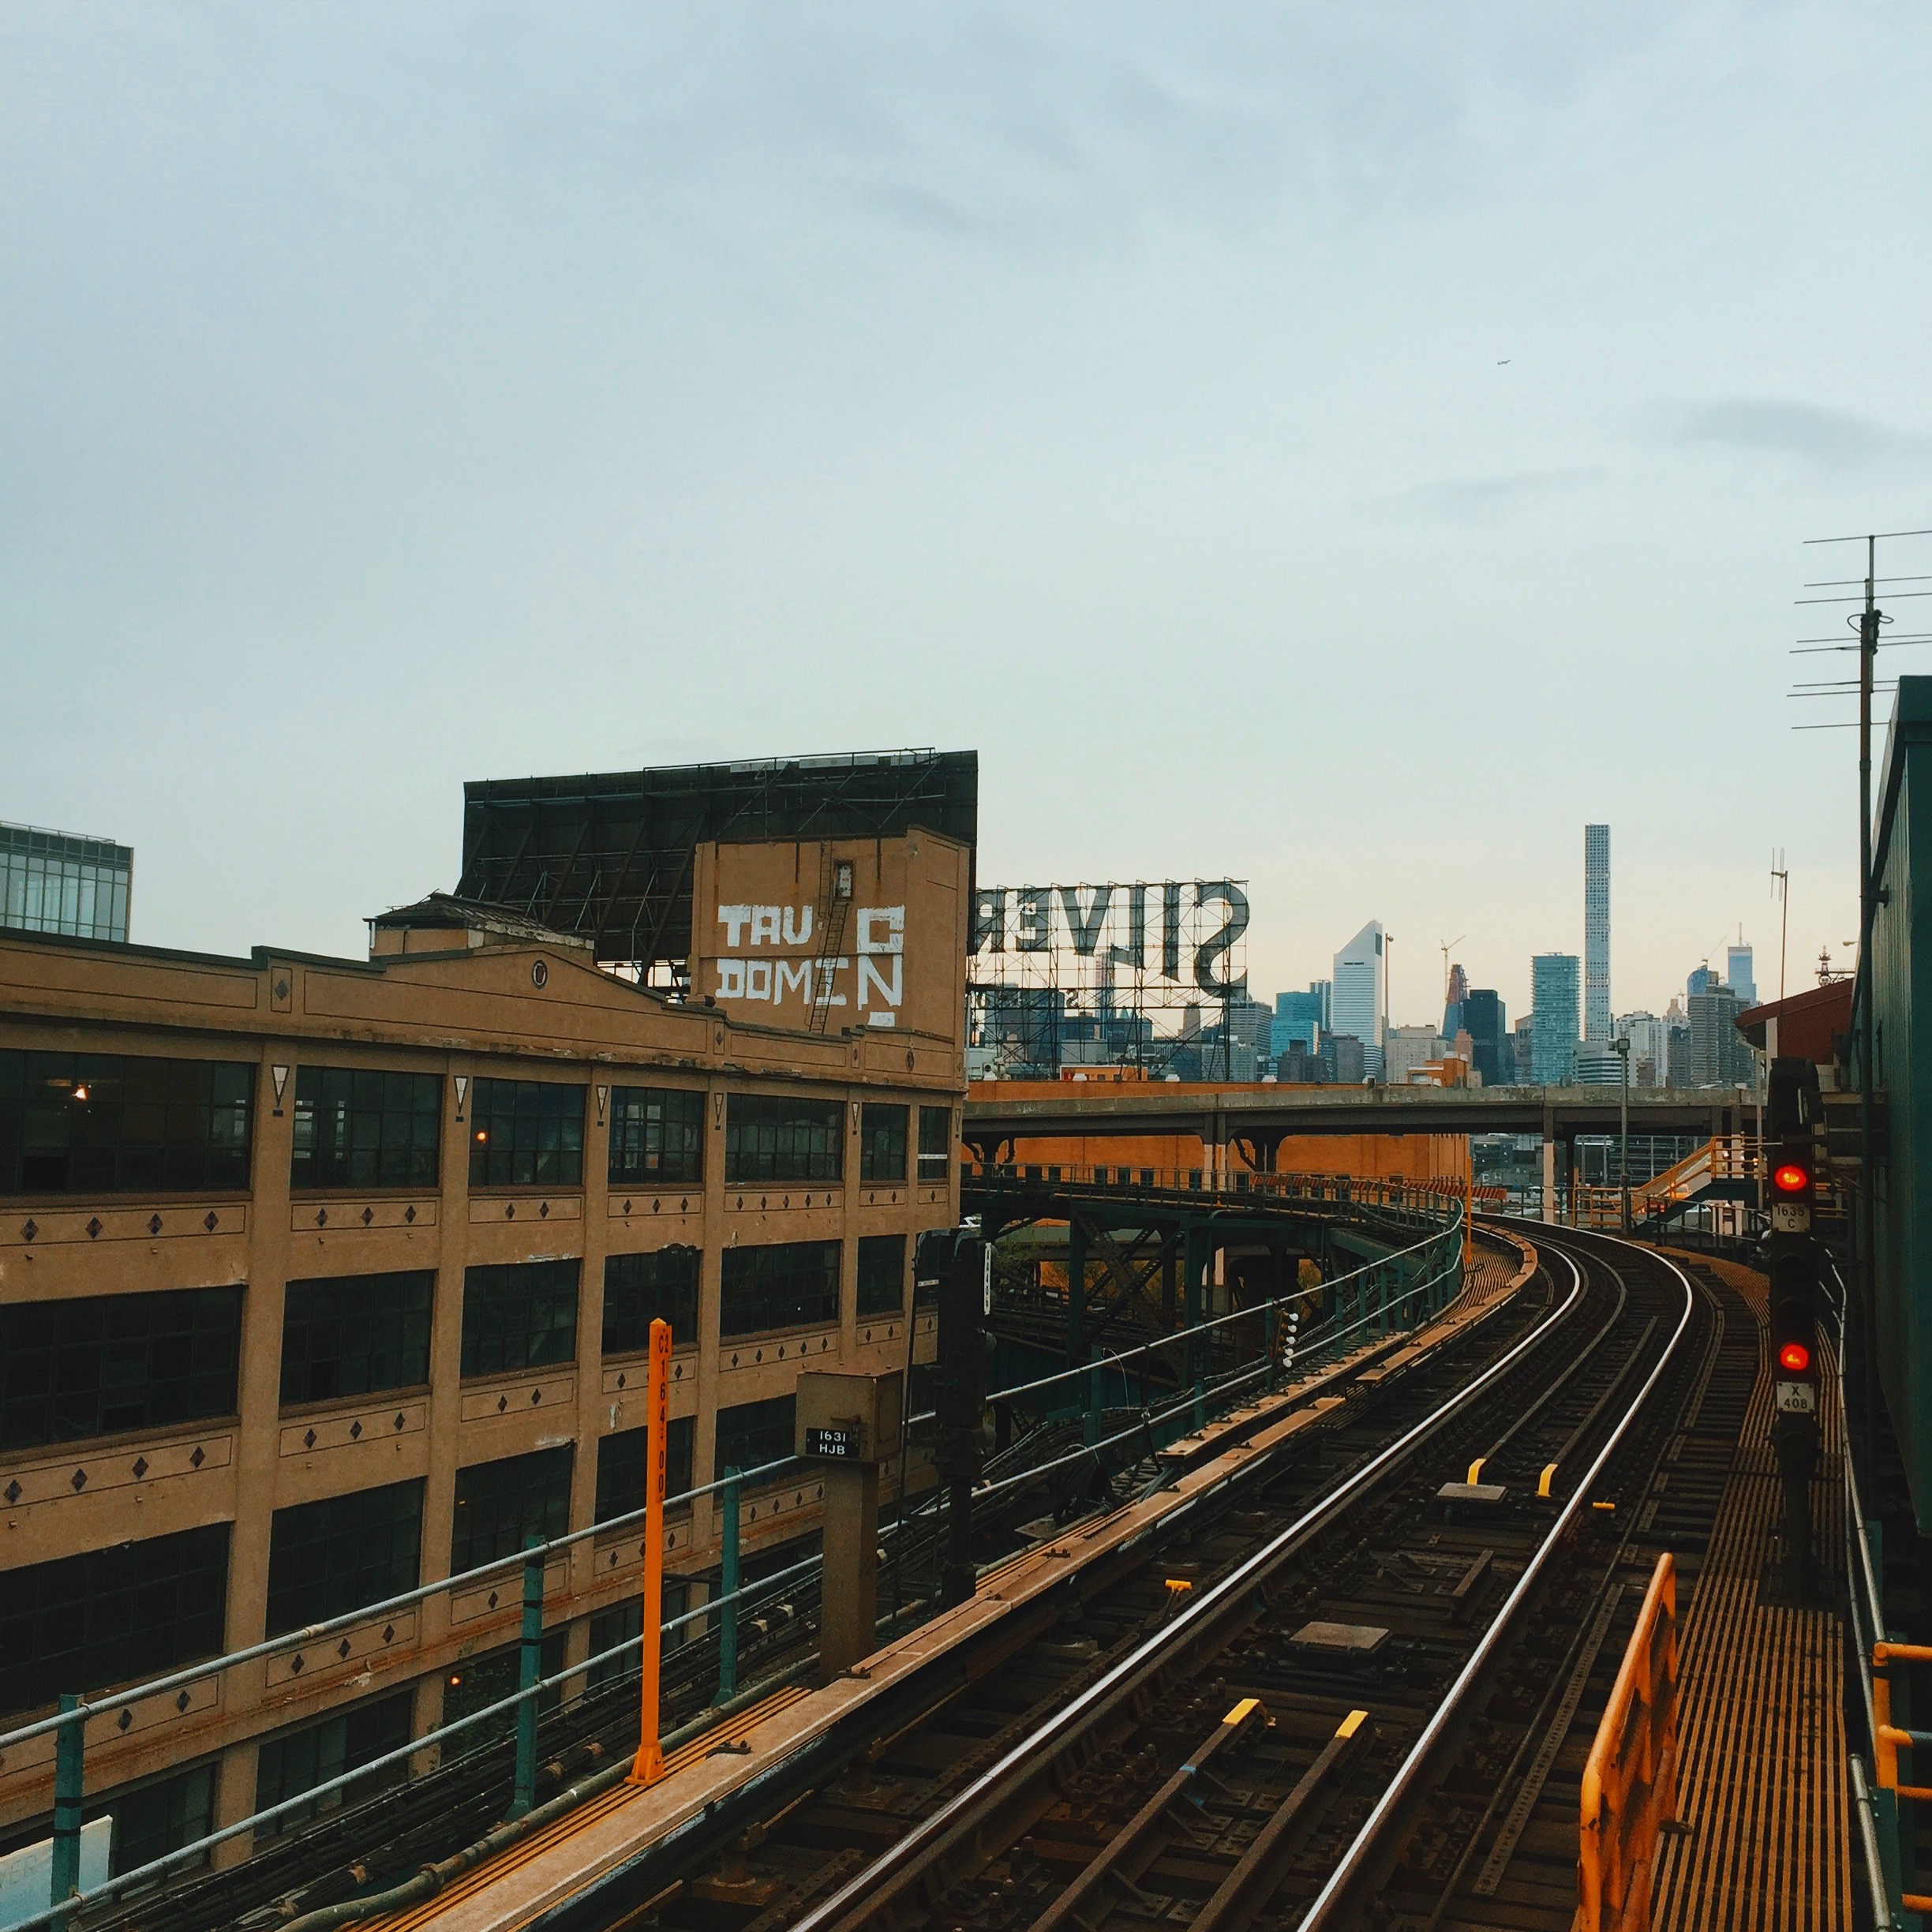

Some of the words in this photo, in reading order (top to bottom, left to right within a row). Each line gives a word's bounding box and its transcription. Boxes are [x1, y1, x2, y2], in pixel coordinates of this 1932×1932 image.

[1787, 1219, 1795, 1229] C
[1784, 1398, 1808, 1409] 408
[819, 1430, 847, 1443] 1631
[819, 1443, 846, 1455] HJB
